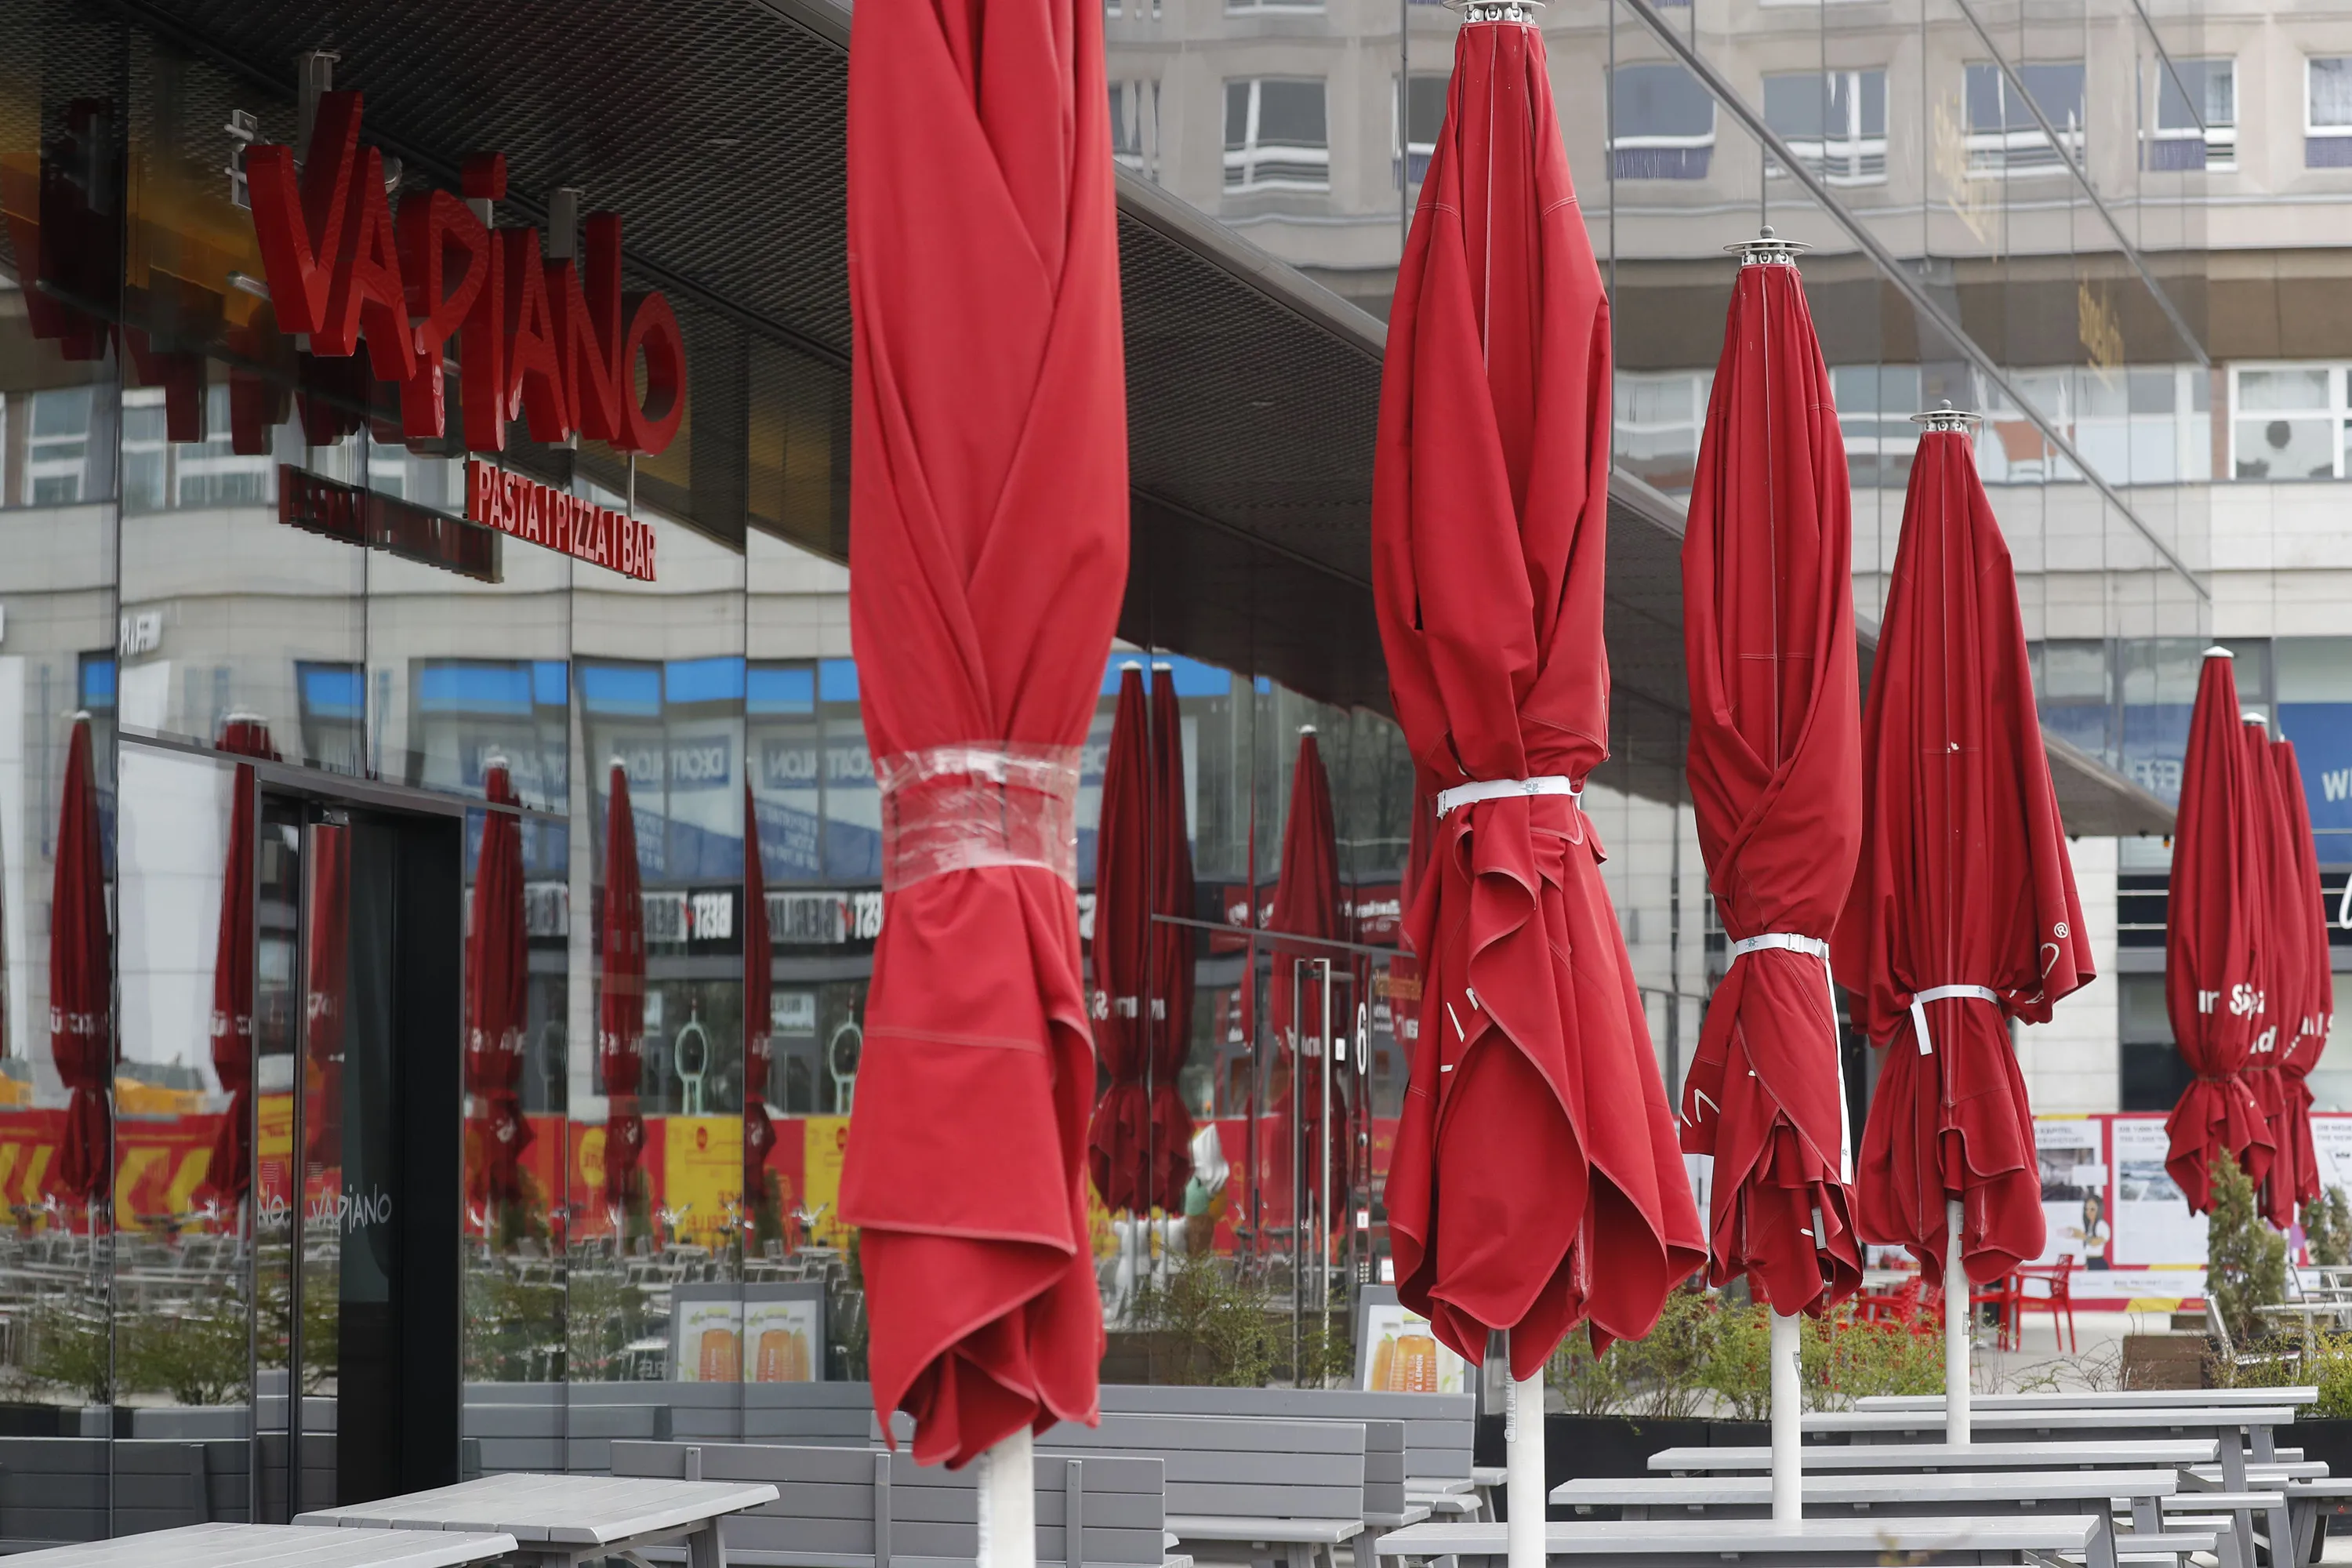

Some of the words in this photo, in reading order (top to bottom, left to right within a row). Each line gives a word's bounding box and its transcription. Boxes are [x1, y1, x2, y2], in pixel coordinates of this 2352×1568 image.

[477, 459, 540, 542] PASTA
[556, 490, 608, 565] PIZZA
[622, 515, 657, 581] BAR
[2321, 768, 2352, 803] W
[1414, 1354, 1424, 1383] LEMON
